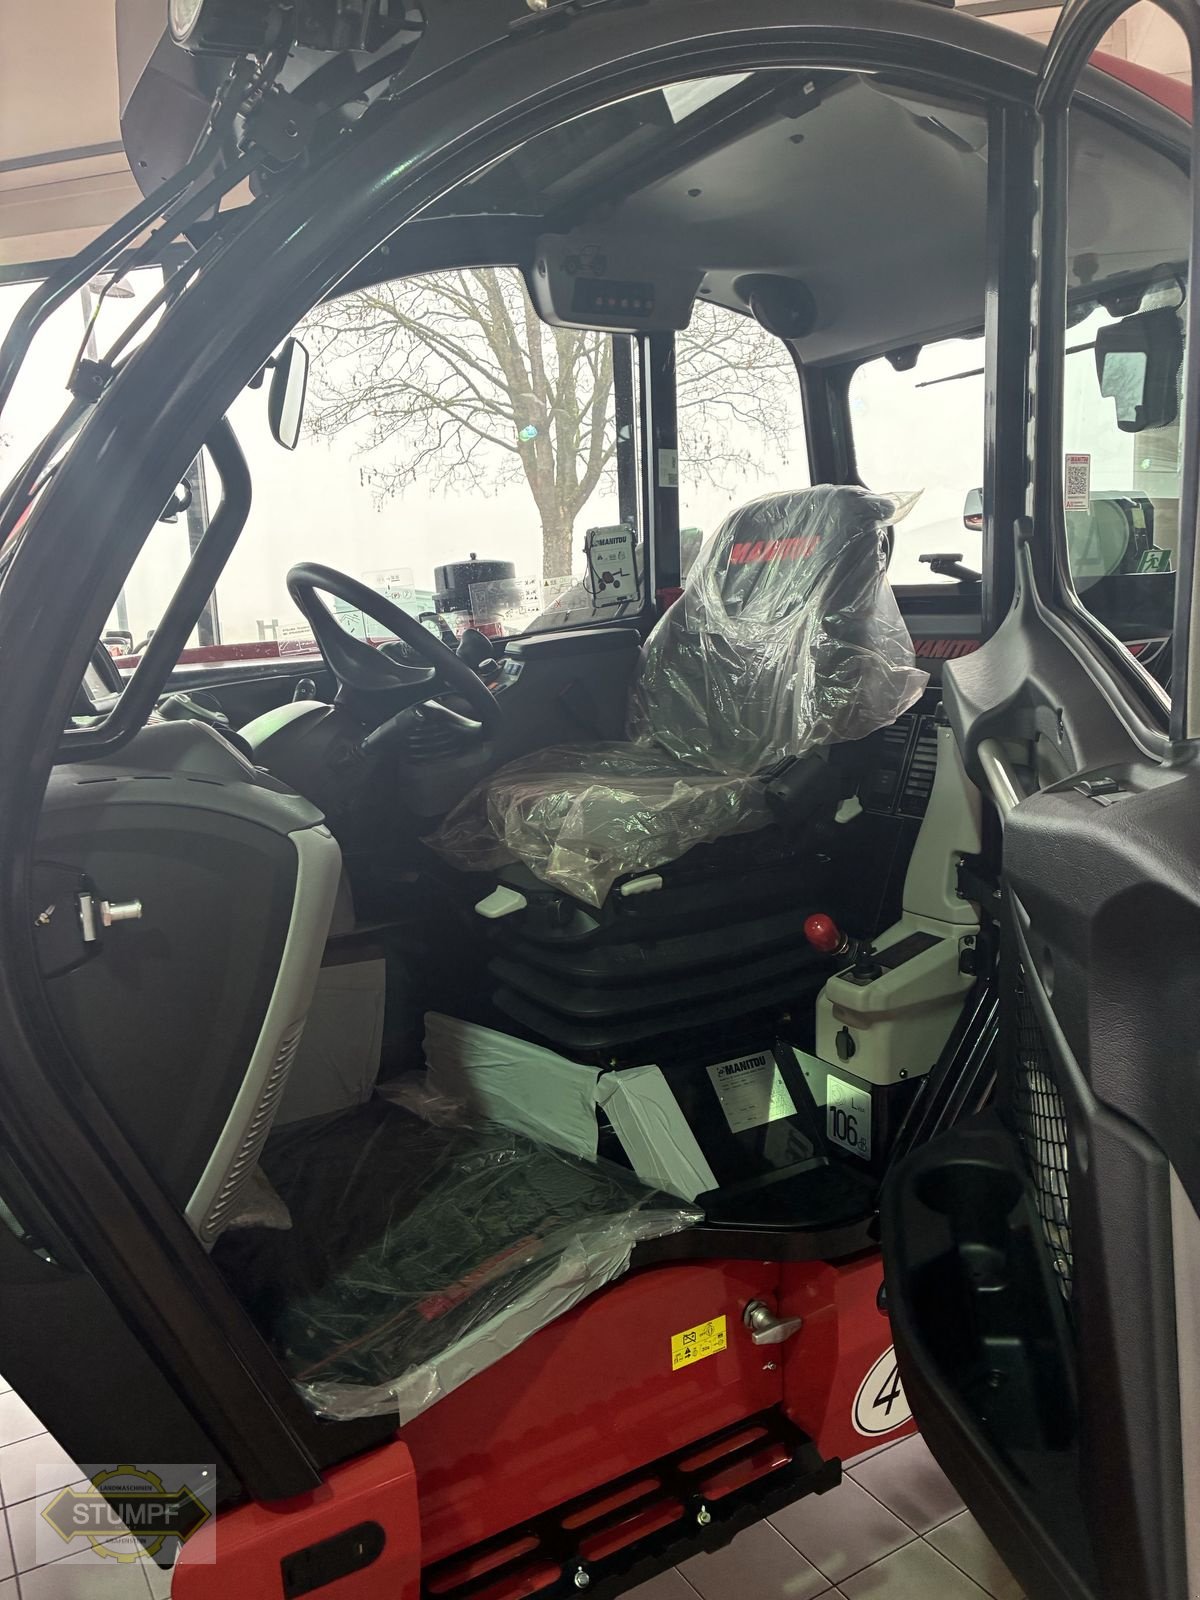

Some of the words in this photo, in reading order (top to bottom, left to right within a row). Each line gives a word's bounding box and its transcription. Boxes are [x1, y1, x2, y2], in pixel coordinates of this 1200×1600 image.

[599, 536, 628, 547] MANITOU
[724, 1055, 767, 1076] MANITOU
[829, 1105, 859, 1147] 106
